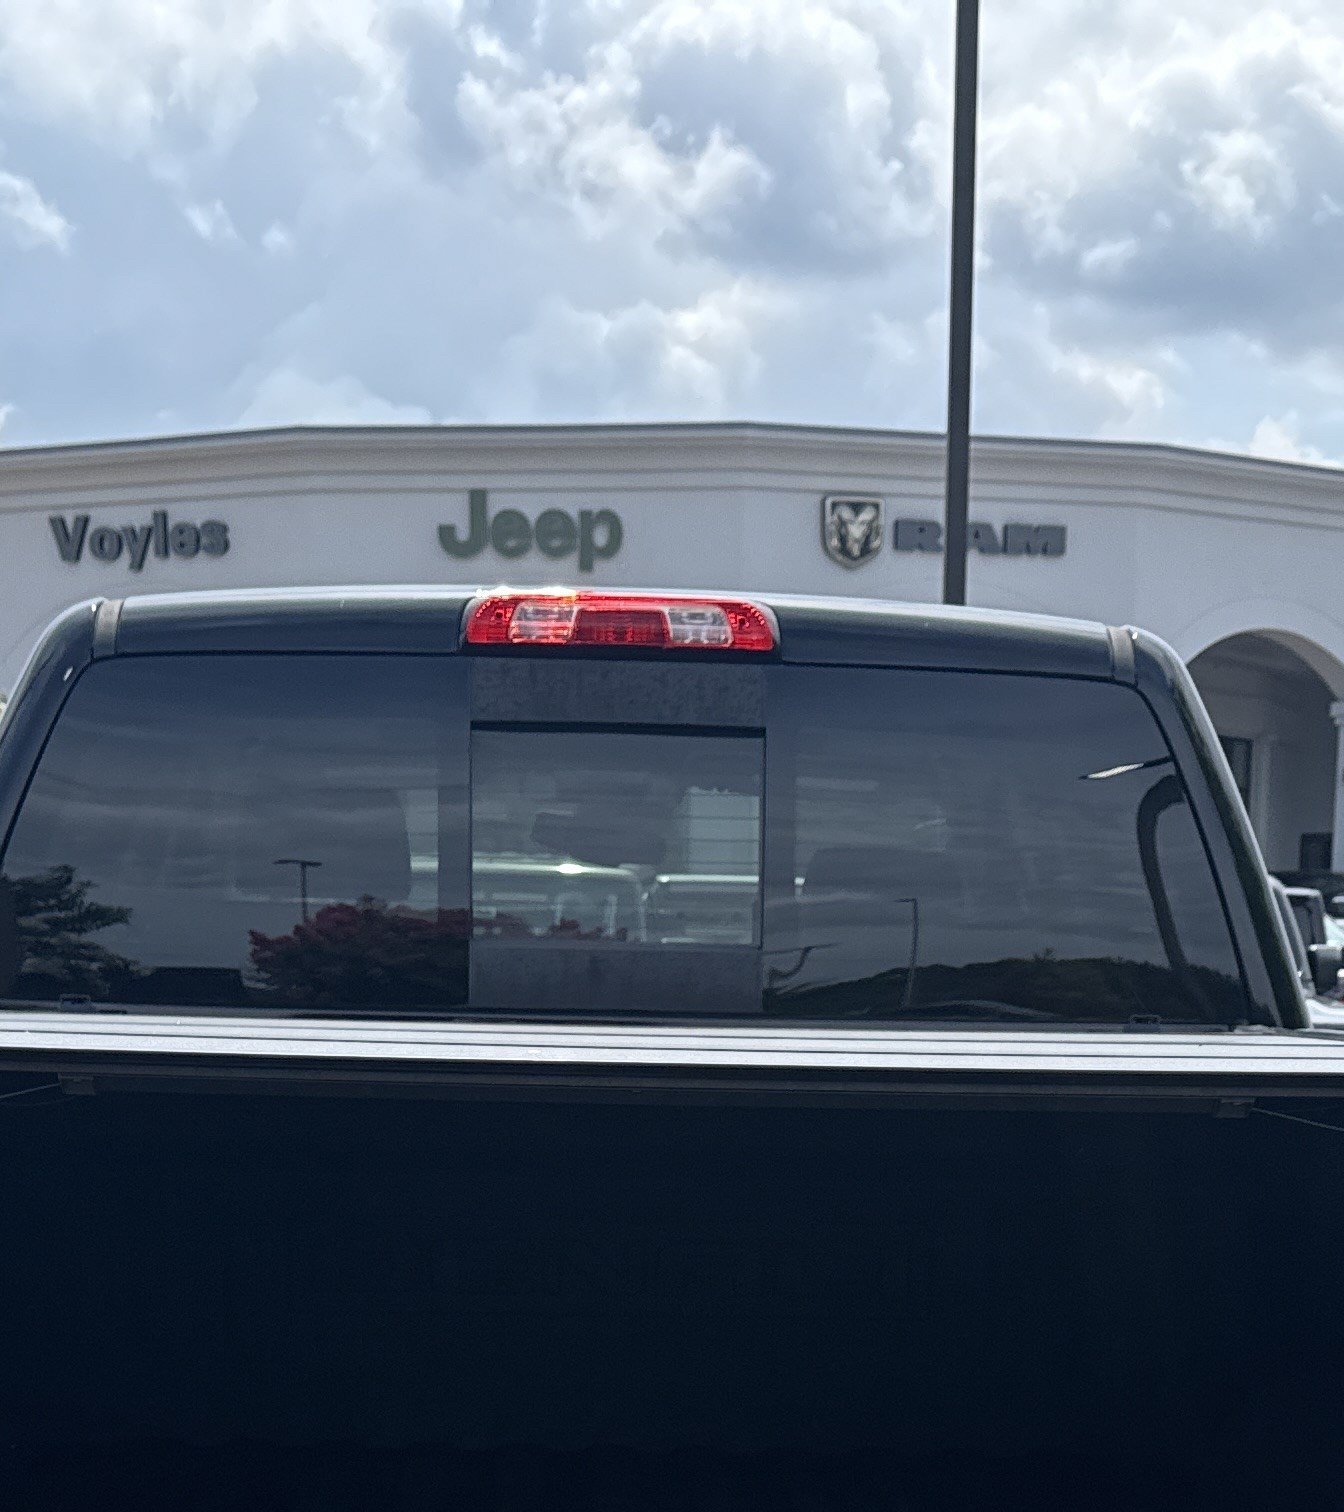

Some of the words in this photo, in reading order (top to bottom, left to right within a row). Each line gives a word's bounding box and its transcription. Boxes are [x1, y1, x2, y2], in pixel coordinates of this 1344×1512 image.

[48, 510, 230, 572] Voyles
[437, 488, 623, 573] Jeep
[893, 518, 1068, 556] RAM
